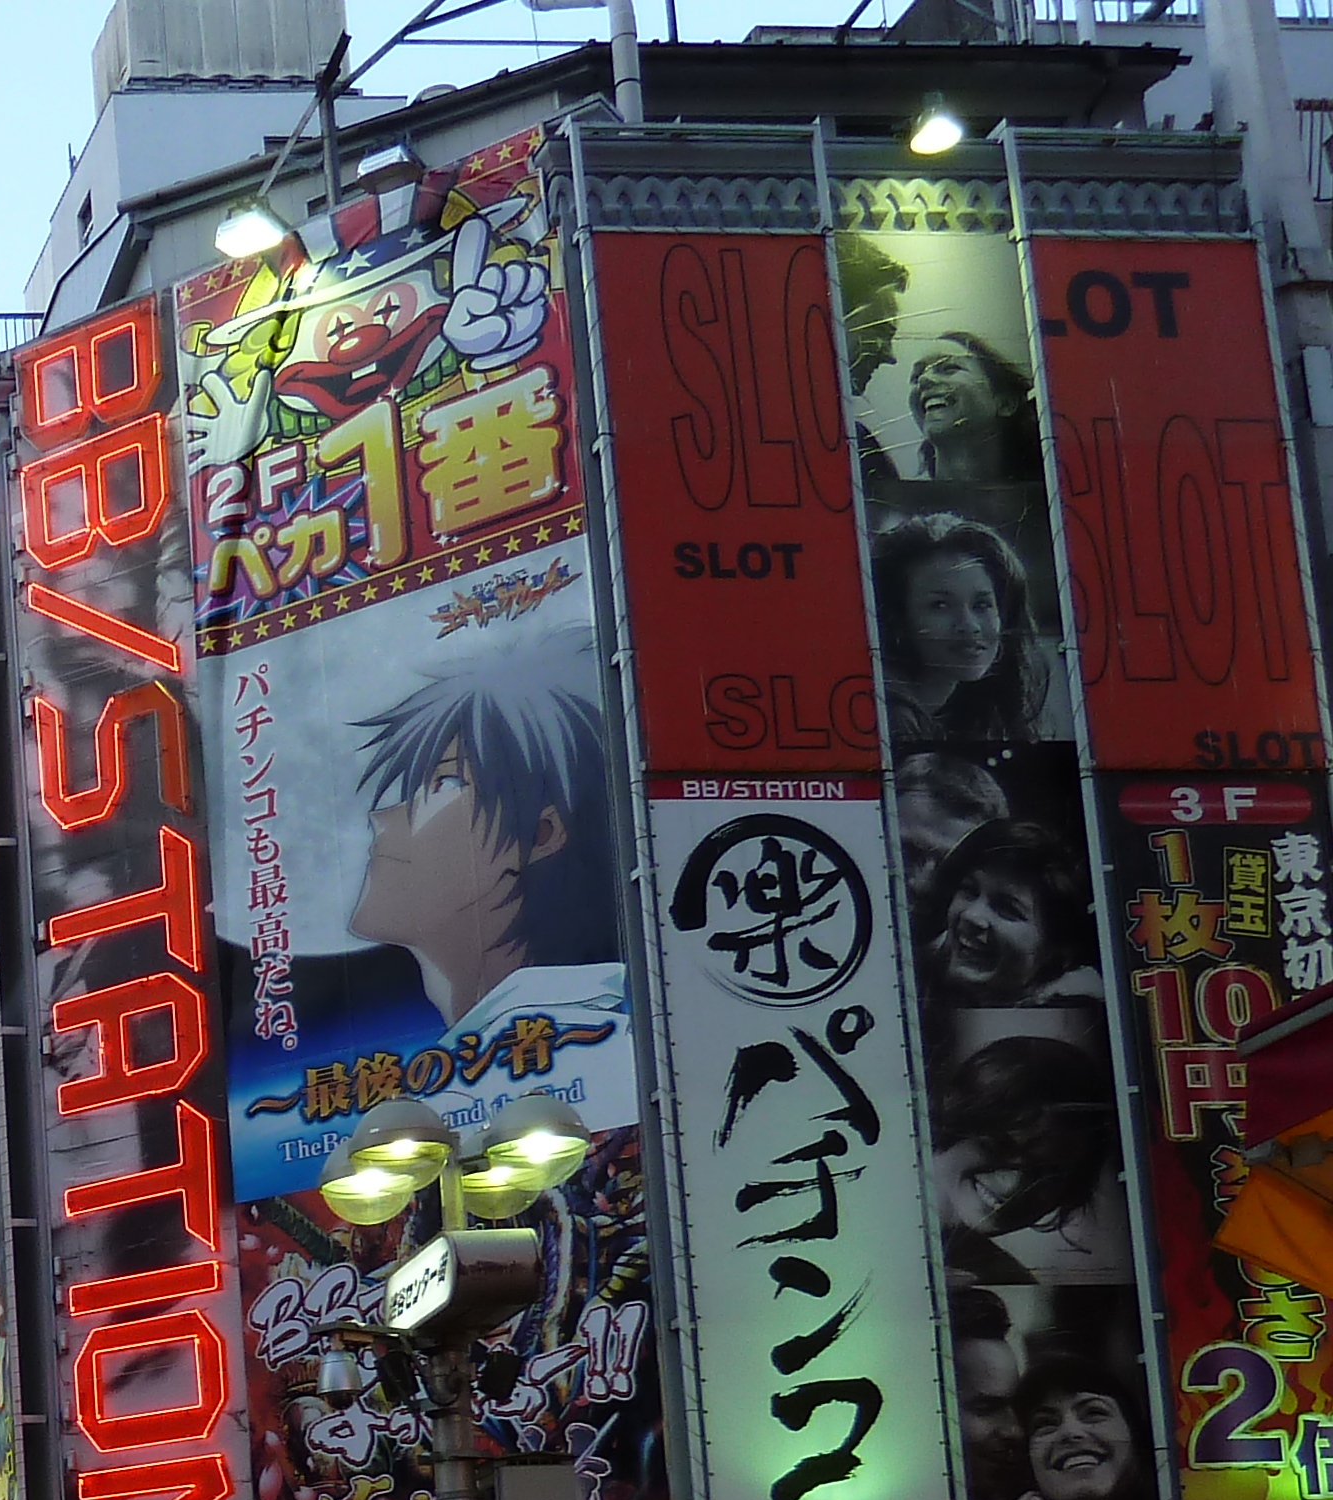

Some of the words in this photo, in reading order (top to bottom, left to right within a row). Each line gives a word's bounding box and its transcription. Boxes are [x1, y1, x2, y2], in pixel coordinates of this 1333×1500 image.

[204, 440, 306, 521] 2F
[674, 541, 803, 581] SLOT
[1194, 731, 1323, 770] SLOT
[681, 778, 845, 800] BB/STATION
[1169, 786, 1258, 823] 3F
[234, 662, 299, 1052] パチンコも最高だね。
[707, 837, 844, 986] 楽
[1227, 851, 1268, 933] 貸玉
